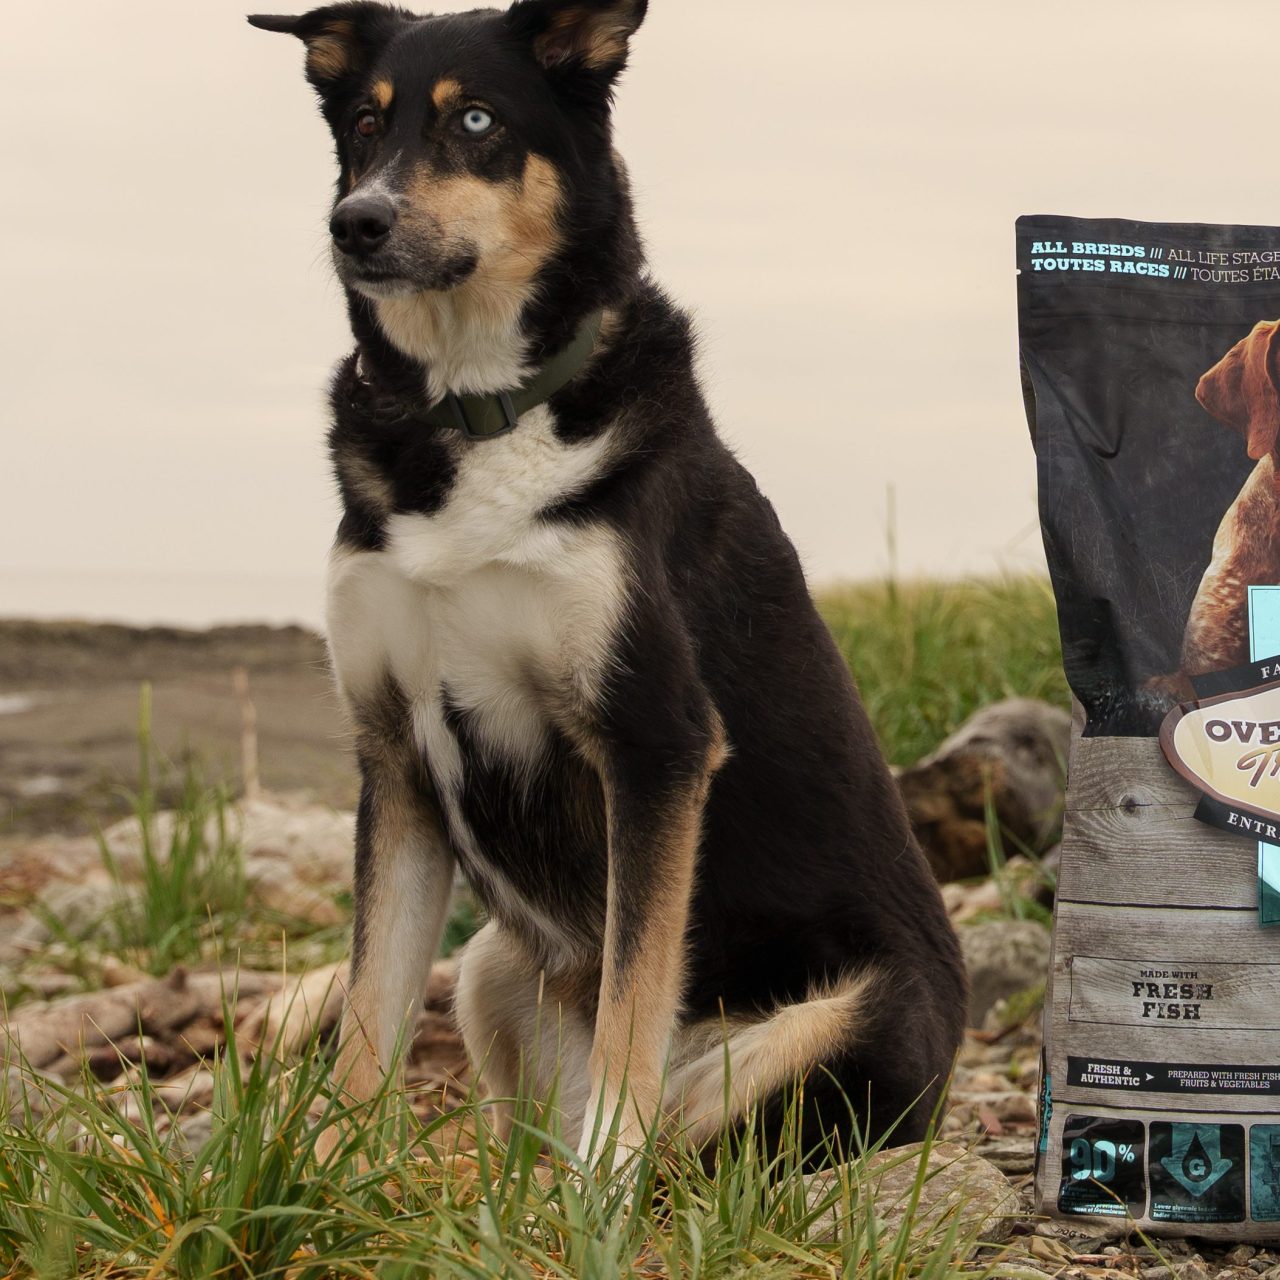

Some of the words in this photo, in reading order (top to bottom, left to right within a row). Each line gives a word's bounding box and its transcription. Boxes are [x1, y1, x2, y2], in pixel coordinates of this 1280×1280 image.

[1031, 241, 1067, 254] ALL
[1072, 242, 1146, 258] BREEDS
[1168, 249, 1195, 262] ALL
[1198, 251, 1229, 265] LIFE
[1031, 258, 1106, 272] TOUTES
[1109, 260, 1170, 278] RACES
[1191, 267, 1250, 283] TOUTES
[1140, 970, 1169, 979] MADE
[1171, 971, 1198, 980] WITH
[1132, 981, 1214, 1000] FRESH
[1142, 1001, 1201, 1020] FISH
[1087, 1063, 1122, 1075] FRESH
[1123, 1066, 1132, 1076] &
[1168, 1070, 1210, 1079] PREPARED
[1211, 1071, 1233, 1080] WITH
[1234, 1072, 1260, 1081] FRESH
[1080, 1073, 1141, 1086] AUTHENTIC
[1180, 1079, 1209, 1088] FRUITS
[1210, 1080, 1217, 1088] &
[1218, 1080, 1270, 1089] VEGETABLES
[1188, 1158, 1206, 1177] G
